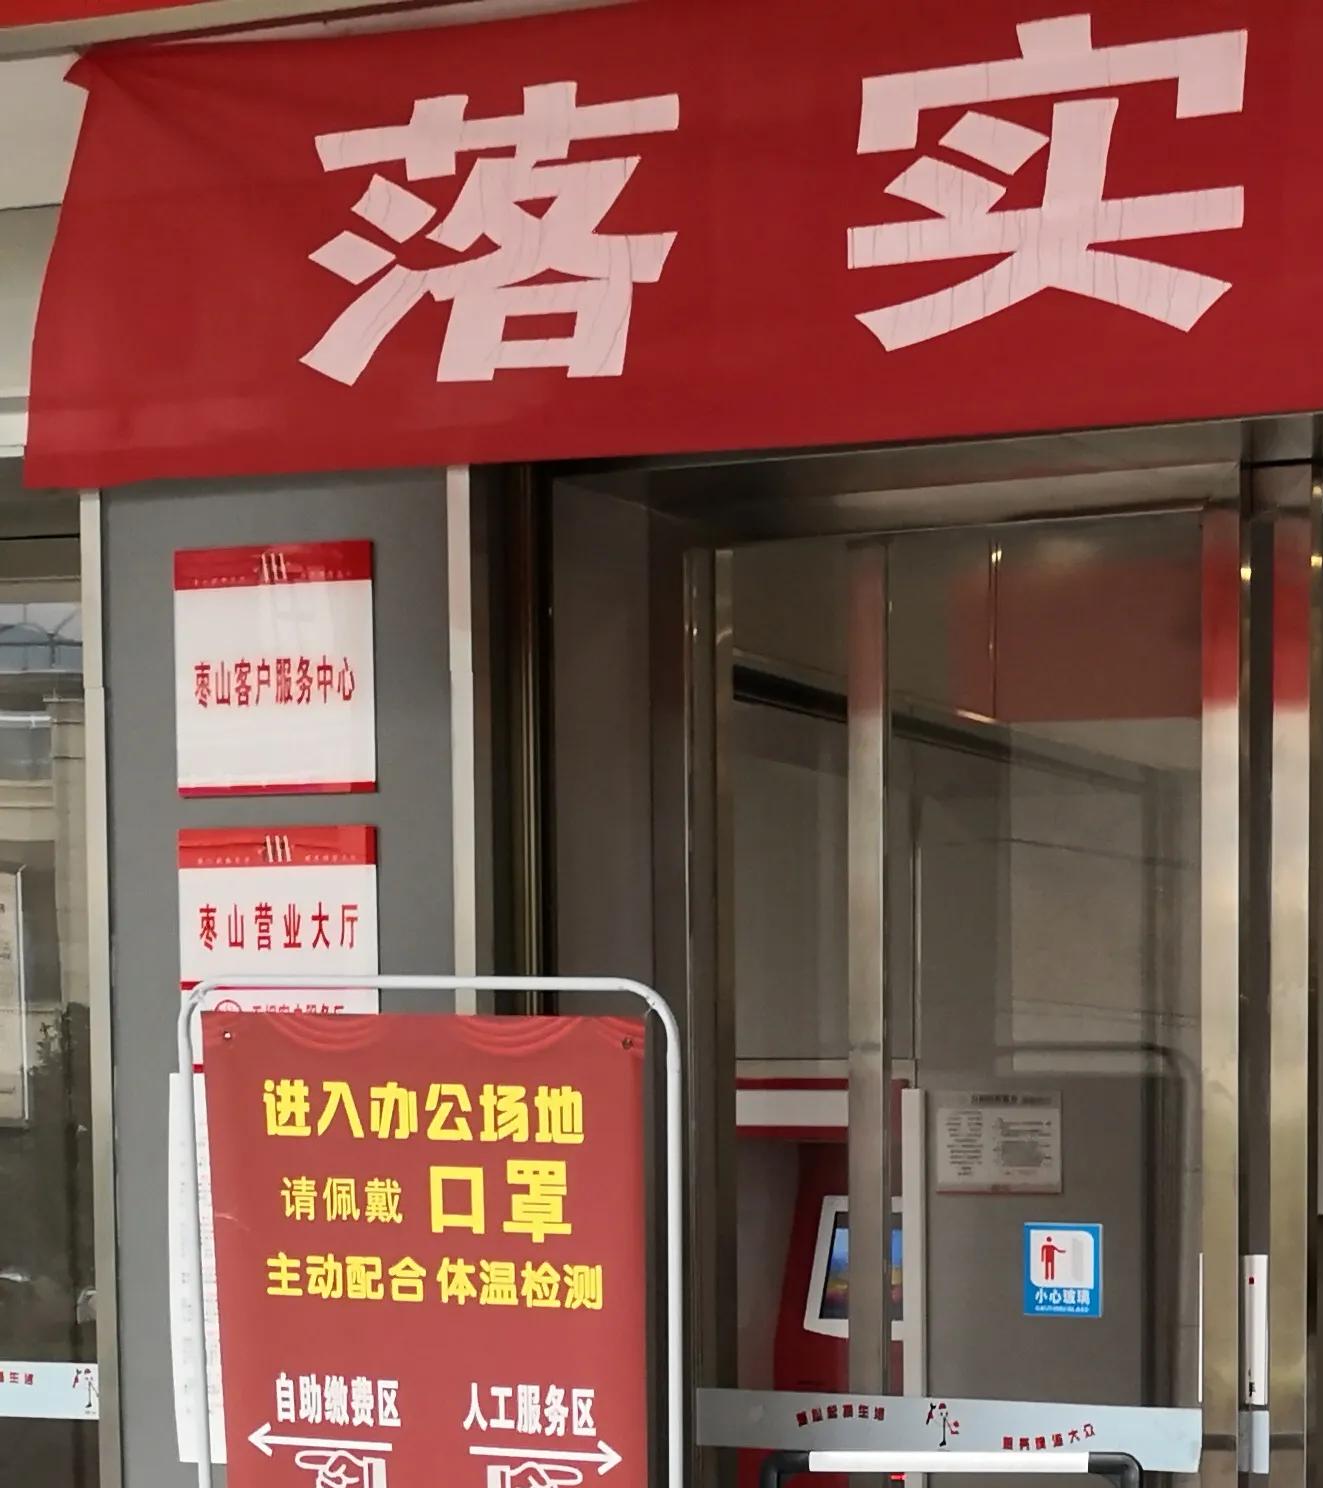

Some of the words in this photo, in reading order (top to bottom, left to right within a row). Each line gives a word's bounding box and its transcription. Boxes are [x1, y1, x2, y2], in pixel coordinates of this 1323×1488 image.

[194, 655, 355, 708] 枣山客户服务中心
[199, 901, 359, 951] 枣山营业大厅
[263, 1078, 585, 1145] 进入办公场地
[281, 1176, 403, 1224] 请佩戴
[430, 1159, 572, 1243] 口罩
[1034, 1287, 1091, 1306] 小心玻璃
[275, 1371, 401, 1428] 自助缴费区
[463, 1382, 597, 1438] 人工服务区
